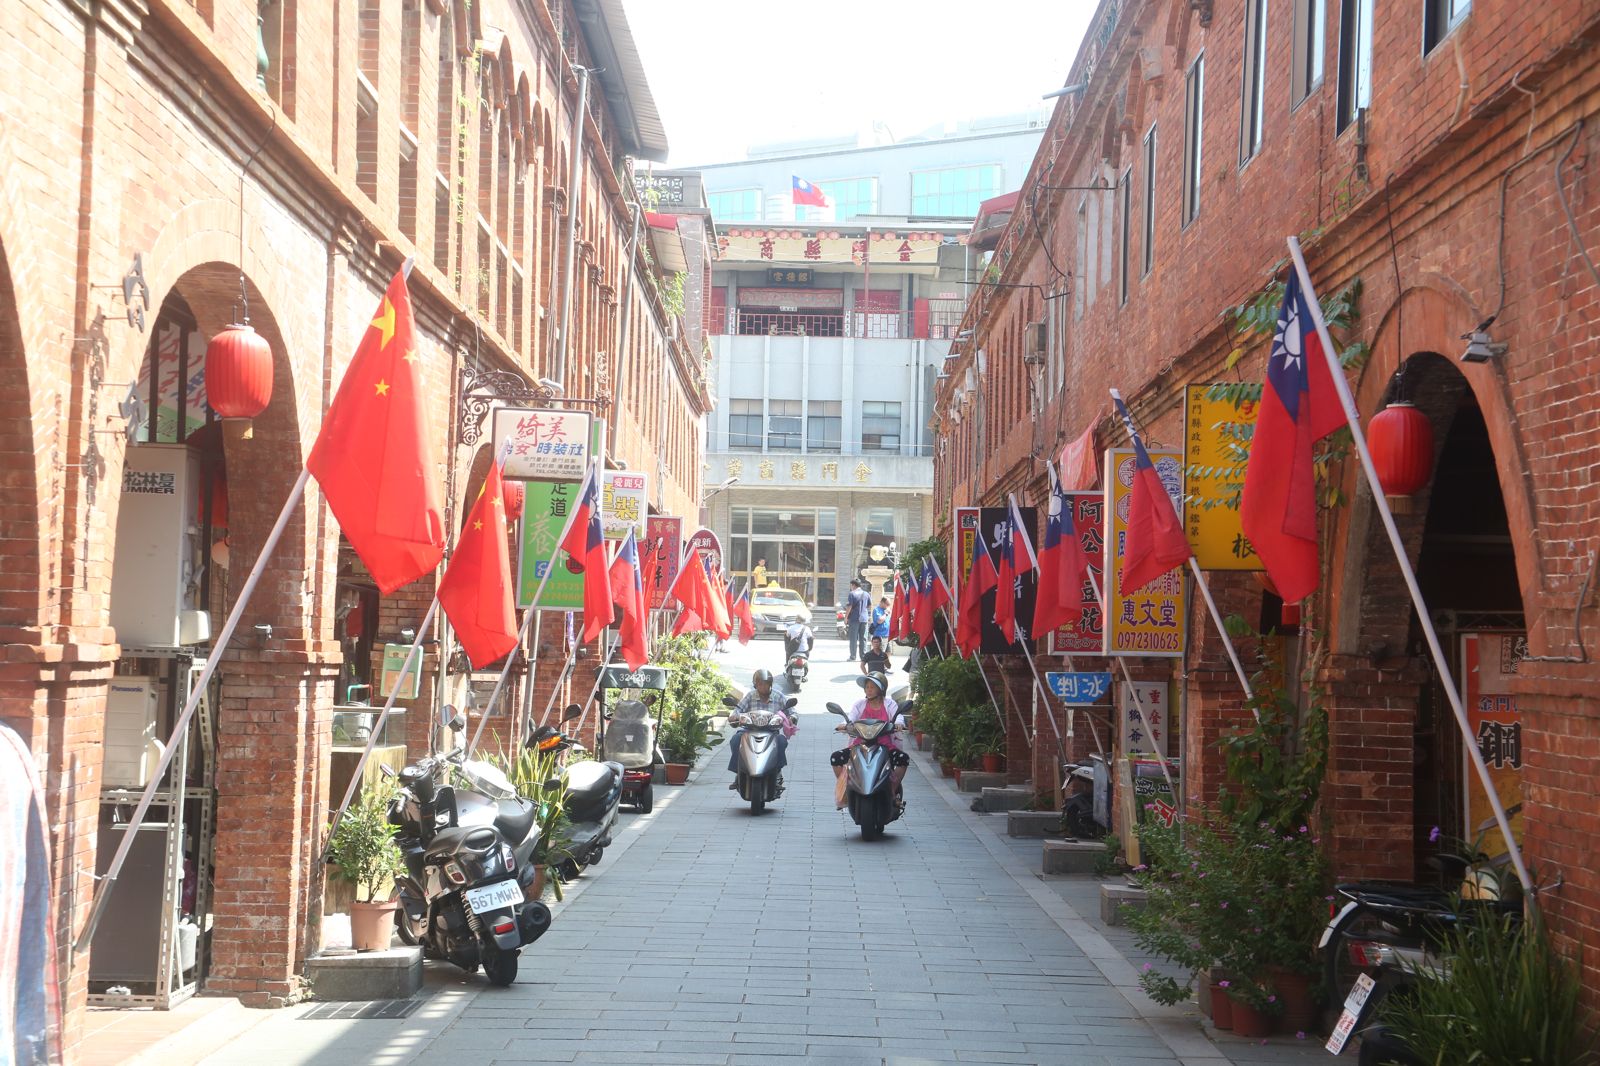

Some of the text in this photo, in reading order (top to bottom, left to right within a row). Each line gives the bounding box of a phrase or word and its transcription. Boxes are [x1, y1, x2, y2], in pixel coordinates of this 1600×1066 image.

[515, 413, 566, 447] 綺美
[1120, 599, 1176, 627] 惠文堂
[1118, 632, 1179, 650] 0972310625
[111, 685, 144, 693] Panasonic
[1057, 675, 1104, 698] 剉冰
[1479, 695, 1519, 712] 金門
